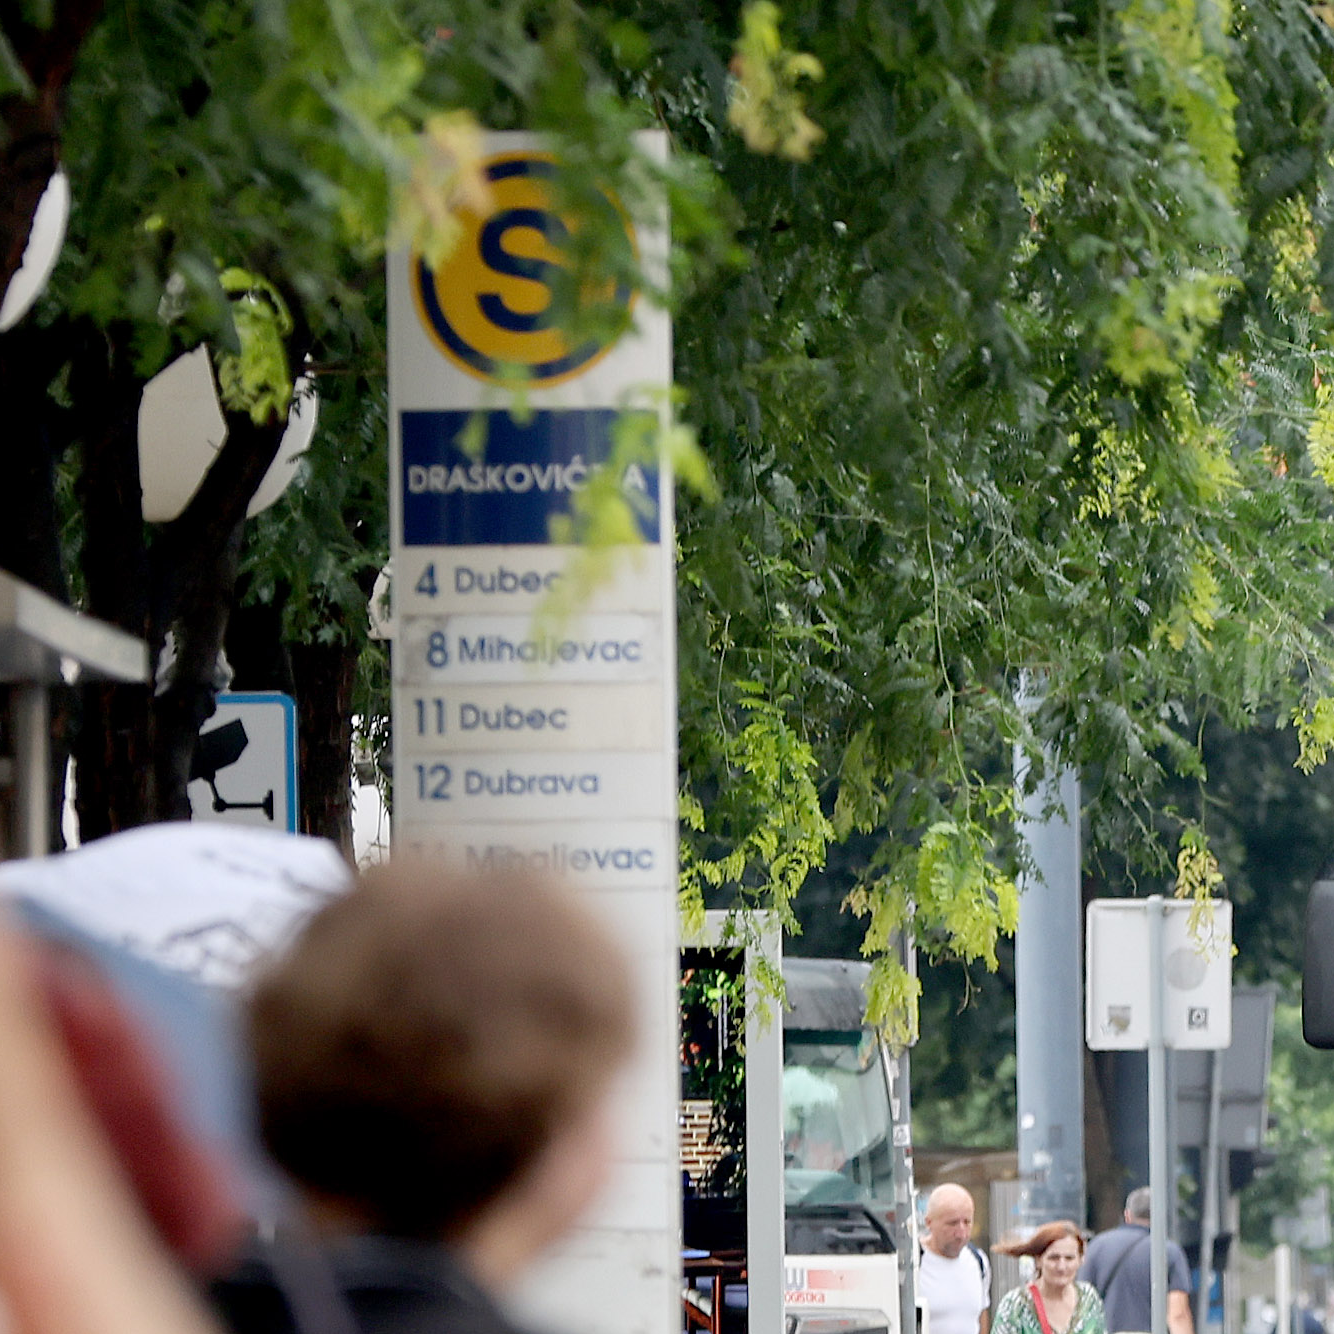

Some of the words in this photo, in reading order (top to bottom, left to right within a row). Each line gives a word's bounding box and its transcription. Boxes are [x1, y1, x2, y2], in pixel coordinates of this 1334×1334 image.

[475, 208, 571, 334] S
[408, 455, 648, 495] DRAŠKOVIĆA
[415, 562, 438, 598] 4
[427, 631, 449, 668] 8
[459, 635, 642, 666] Mihaljevac
[415, 697, 445, 736] 11
[460, 702, 567, 731] Dubec
[415, 763, 452, 800] 12
[464, 769, 600, 796] Dubrava
